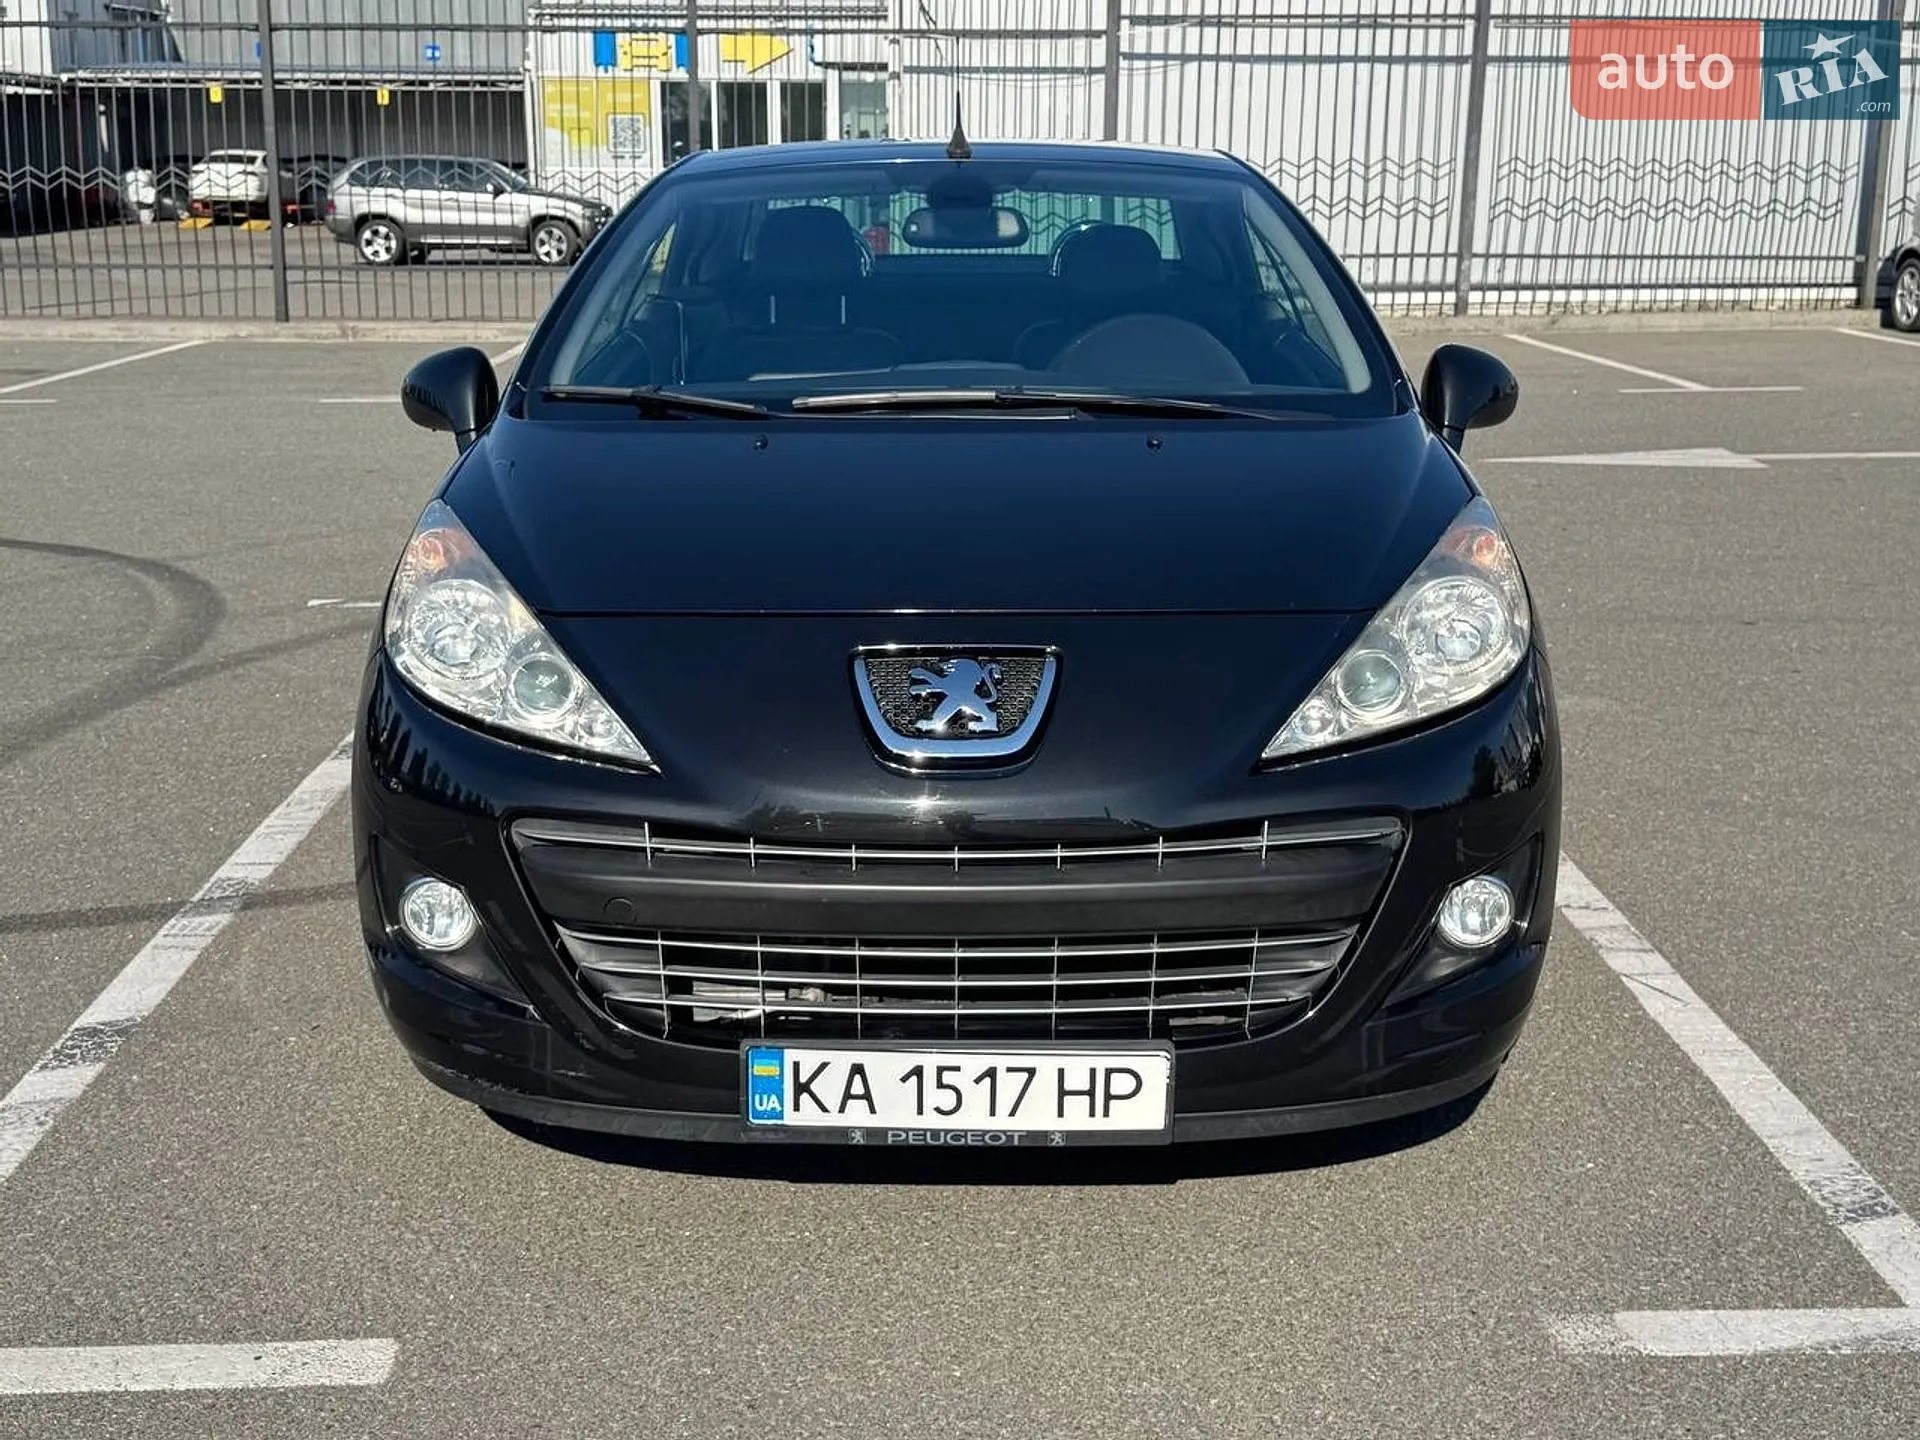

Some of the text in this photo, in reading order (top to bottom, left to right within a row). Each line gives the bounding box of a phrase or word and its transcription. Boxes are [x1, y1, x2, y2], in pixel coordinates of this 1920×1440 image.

[791, 1060, 1144, 1119] KA 1517 HP
[754, 1093, 782, 1112] UA
[887, 1130, 1028, 1146] PEUGEOT
